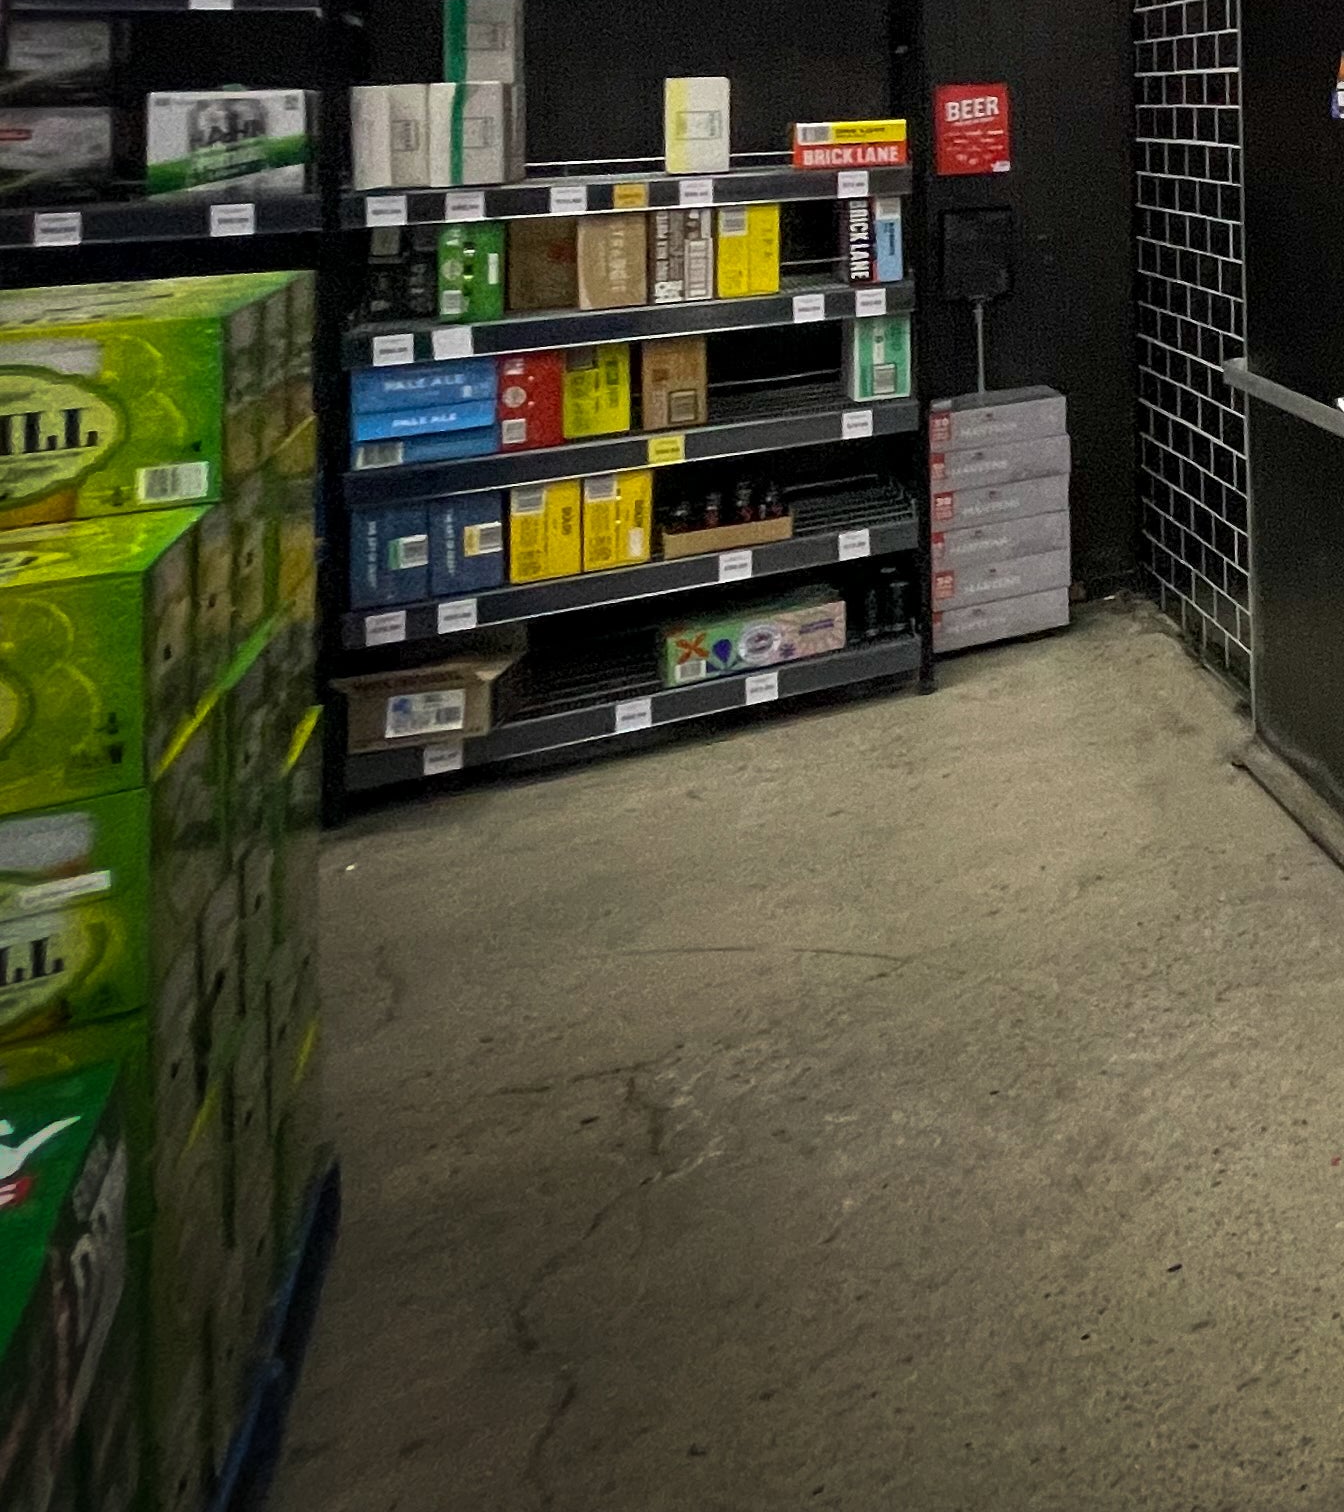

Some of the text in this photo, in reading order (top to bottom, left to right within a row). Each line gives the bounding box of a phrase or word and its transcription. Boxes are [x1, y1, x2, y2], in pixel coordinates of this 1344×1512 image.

[945, 96, 999, 122] BEER
[803, 146, 898, 165] BRICK LANE
